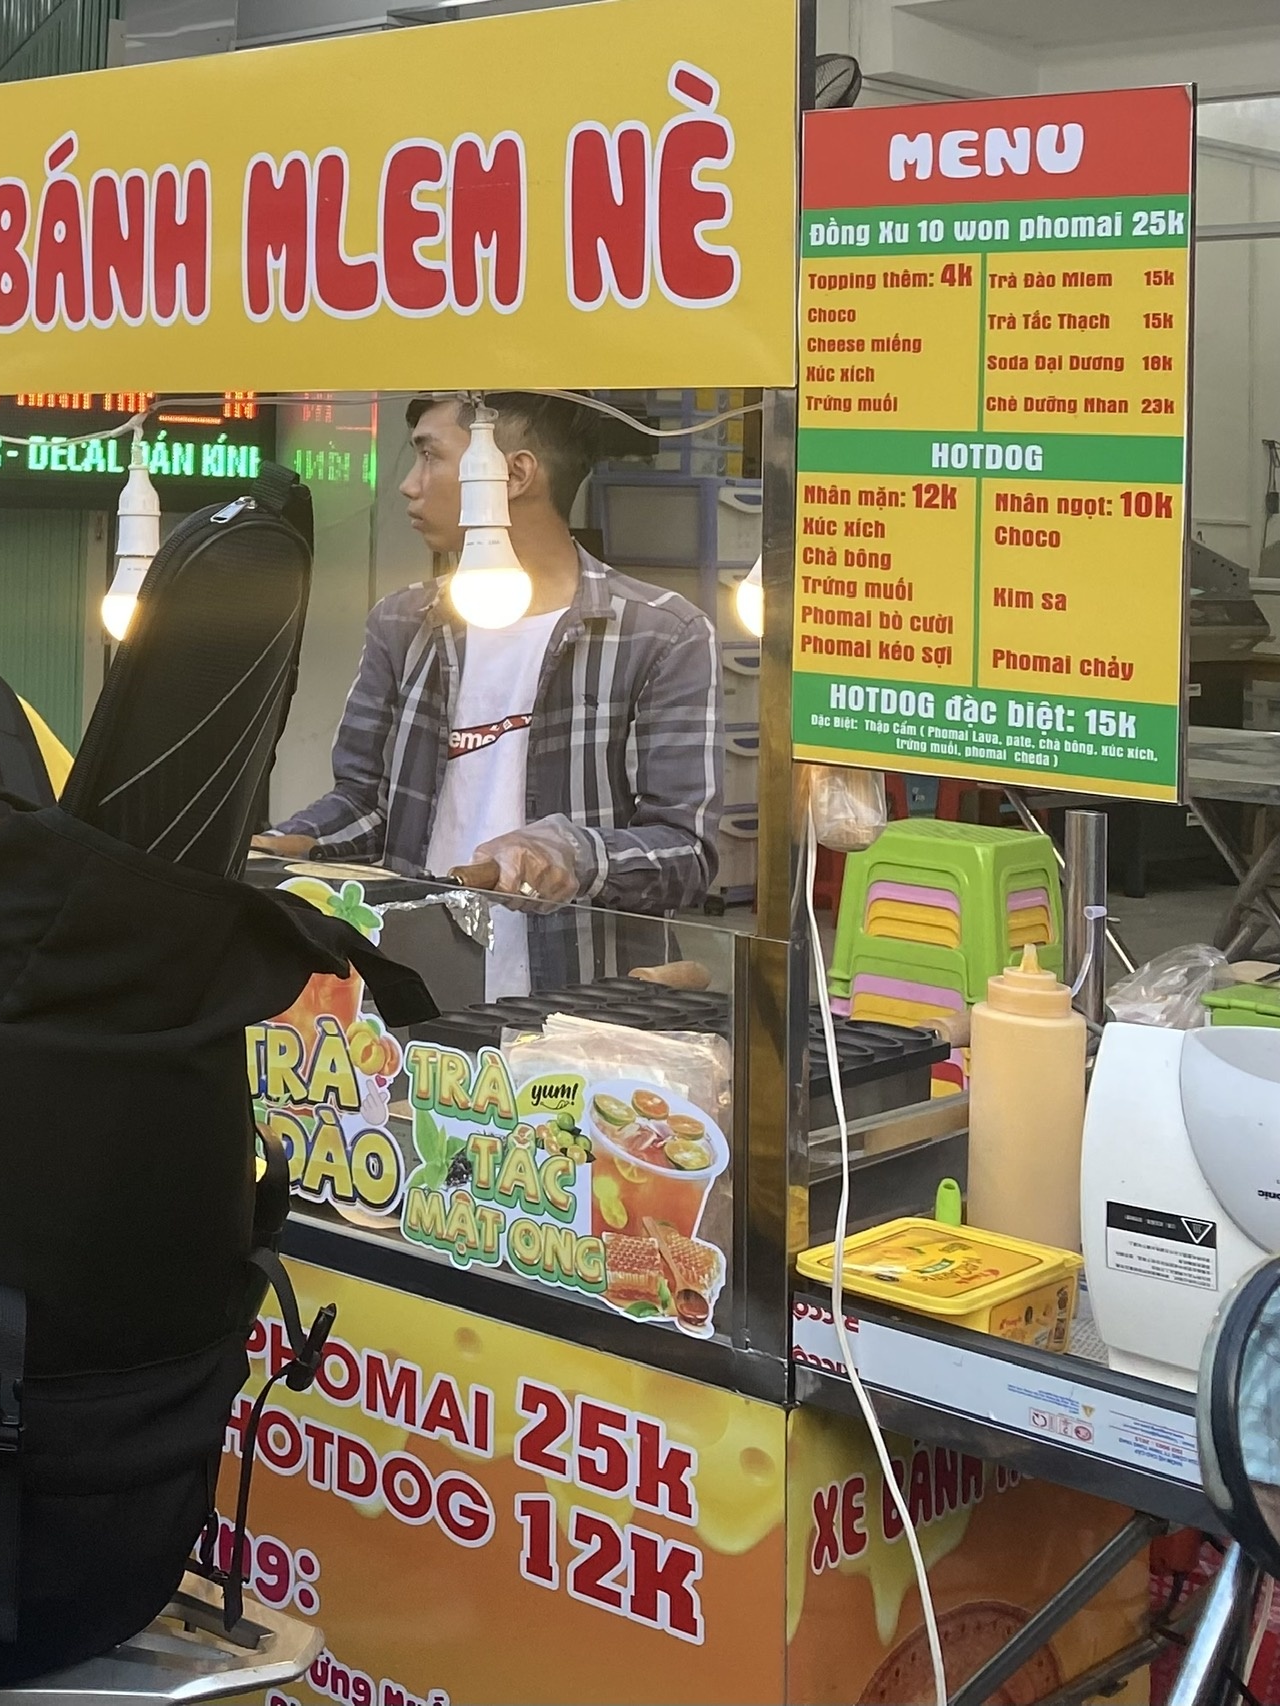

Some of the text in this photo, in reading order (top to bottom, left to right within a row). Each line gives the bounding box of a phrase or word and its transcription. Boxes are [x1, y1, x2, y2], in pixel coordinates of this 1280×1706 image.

[888, 122, 1084, 182] MENU
[243, 129, 524, 322] MLEM
[565, 60, 739, 311] NÈ
[809, 209, 1184, 247] Đồng Xu 10 won phomai 25k
[808, 263, 973, 291] Topping thêm: 4k
[989, 272, 1017, 289] Trà
[1023, 271, 1056, 289] Đào
[1143, 270, 1175, 287] 15k
[807, 307, 857, 324] Choco
[988, 310, 1174, 333] Trà Tắc Thạch 15k
[807, 333, 922, 354] Cheese miếng
[806, 365, 875, 383] Xúc xích
[987, 354, 1029, 372] Soda
[1035, 354, 1063, 374] Đại
[1069, 354, 1125, 373] Dương
[806, 392, 898, 413] Trứng muối
[986, 394, 1175, 415] Chè Dưỡng Nhan 23k
[28, 435, 124, 473] DECAL
[931, 441, 1044, 472] HOTDOG
[803, 482, 958, 510] Nhân mặn: 12k
[995, 491, 1173, 520] Nhân ngọt: 10k
[802, 517, 886, 539] Xúc xích
[994, 525, 1062, 549] Choco
[844, 547, 892, 571] bông
[801, 575, 913, 602] Trứng muối
[993, 586, 1067, 612] Kim sa
[801, 605, 954, 635] Phomai bò cười
[800, 635, 952, 668] Phomai kéo sợi
[991, 648, 1134, 682] Phomai chảy
[830, 683, 935, 719] HOTDOG
[1008, 700, 1075, 735] biệt:
[1085, 708, 1137, 739] 15k
[927, 727, 968, 742] Phomai
[965, 745, 1007, 761] phomai
[1014, 750, 1050, 766] cheda
[245, 1018, 361, 1110] TRÀ
[411, 1050, 515, 1120] TRÀ
[530, 1083, 578, 1107] yum!
[406, 1188, 608, 1290] MẬT ONG
[813, 1477, 867, 1571] XE
